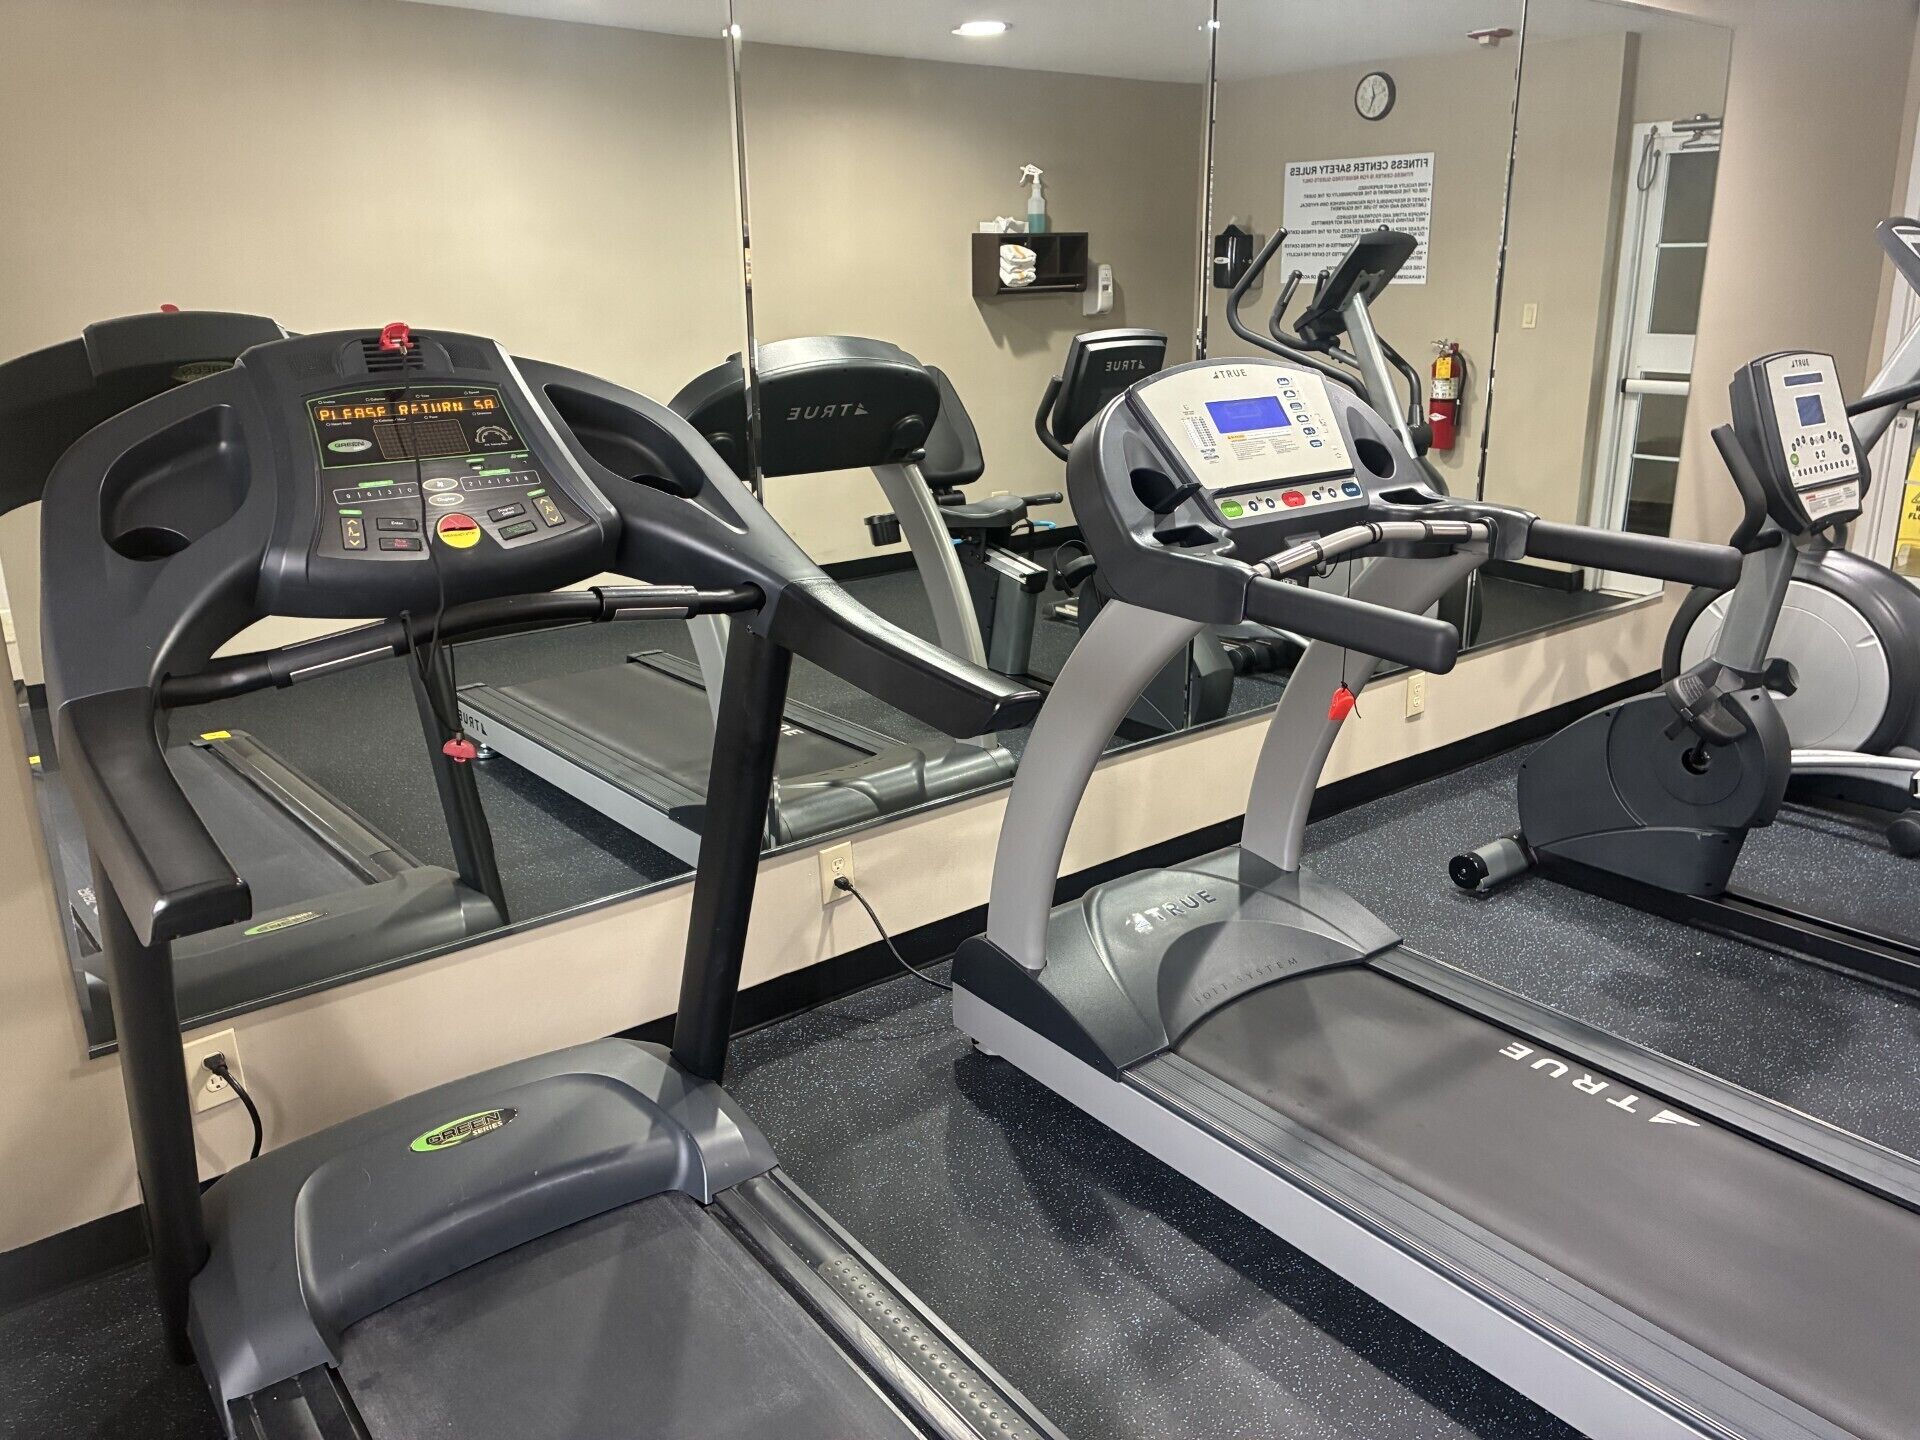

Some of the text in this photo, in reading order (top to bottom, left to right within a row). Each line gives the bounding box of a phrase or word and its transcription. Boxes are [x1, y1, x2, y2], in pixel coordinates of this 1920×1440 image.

[1219, 369, 1248, 378] TRUE
[1148, 889, 1217, 922] TRUE
[1236, 957, 1298, 982] SYSTEM
[1498, 1041, 1640, 1114] TRUE
[426, 1111, 500, 1145] GREEN
[472, 1120, 503, 1136] SERIES
